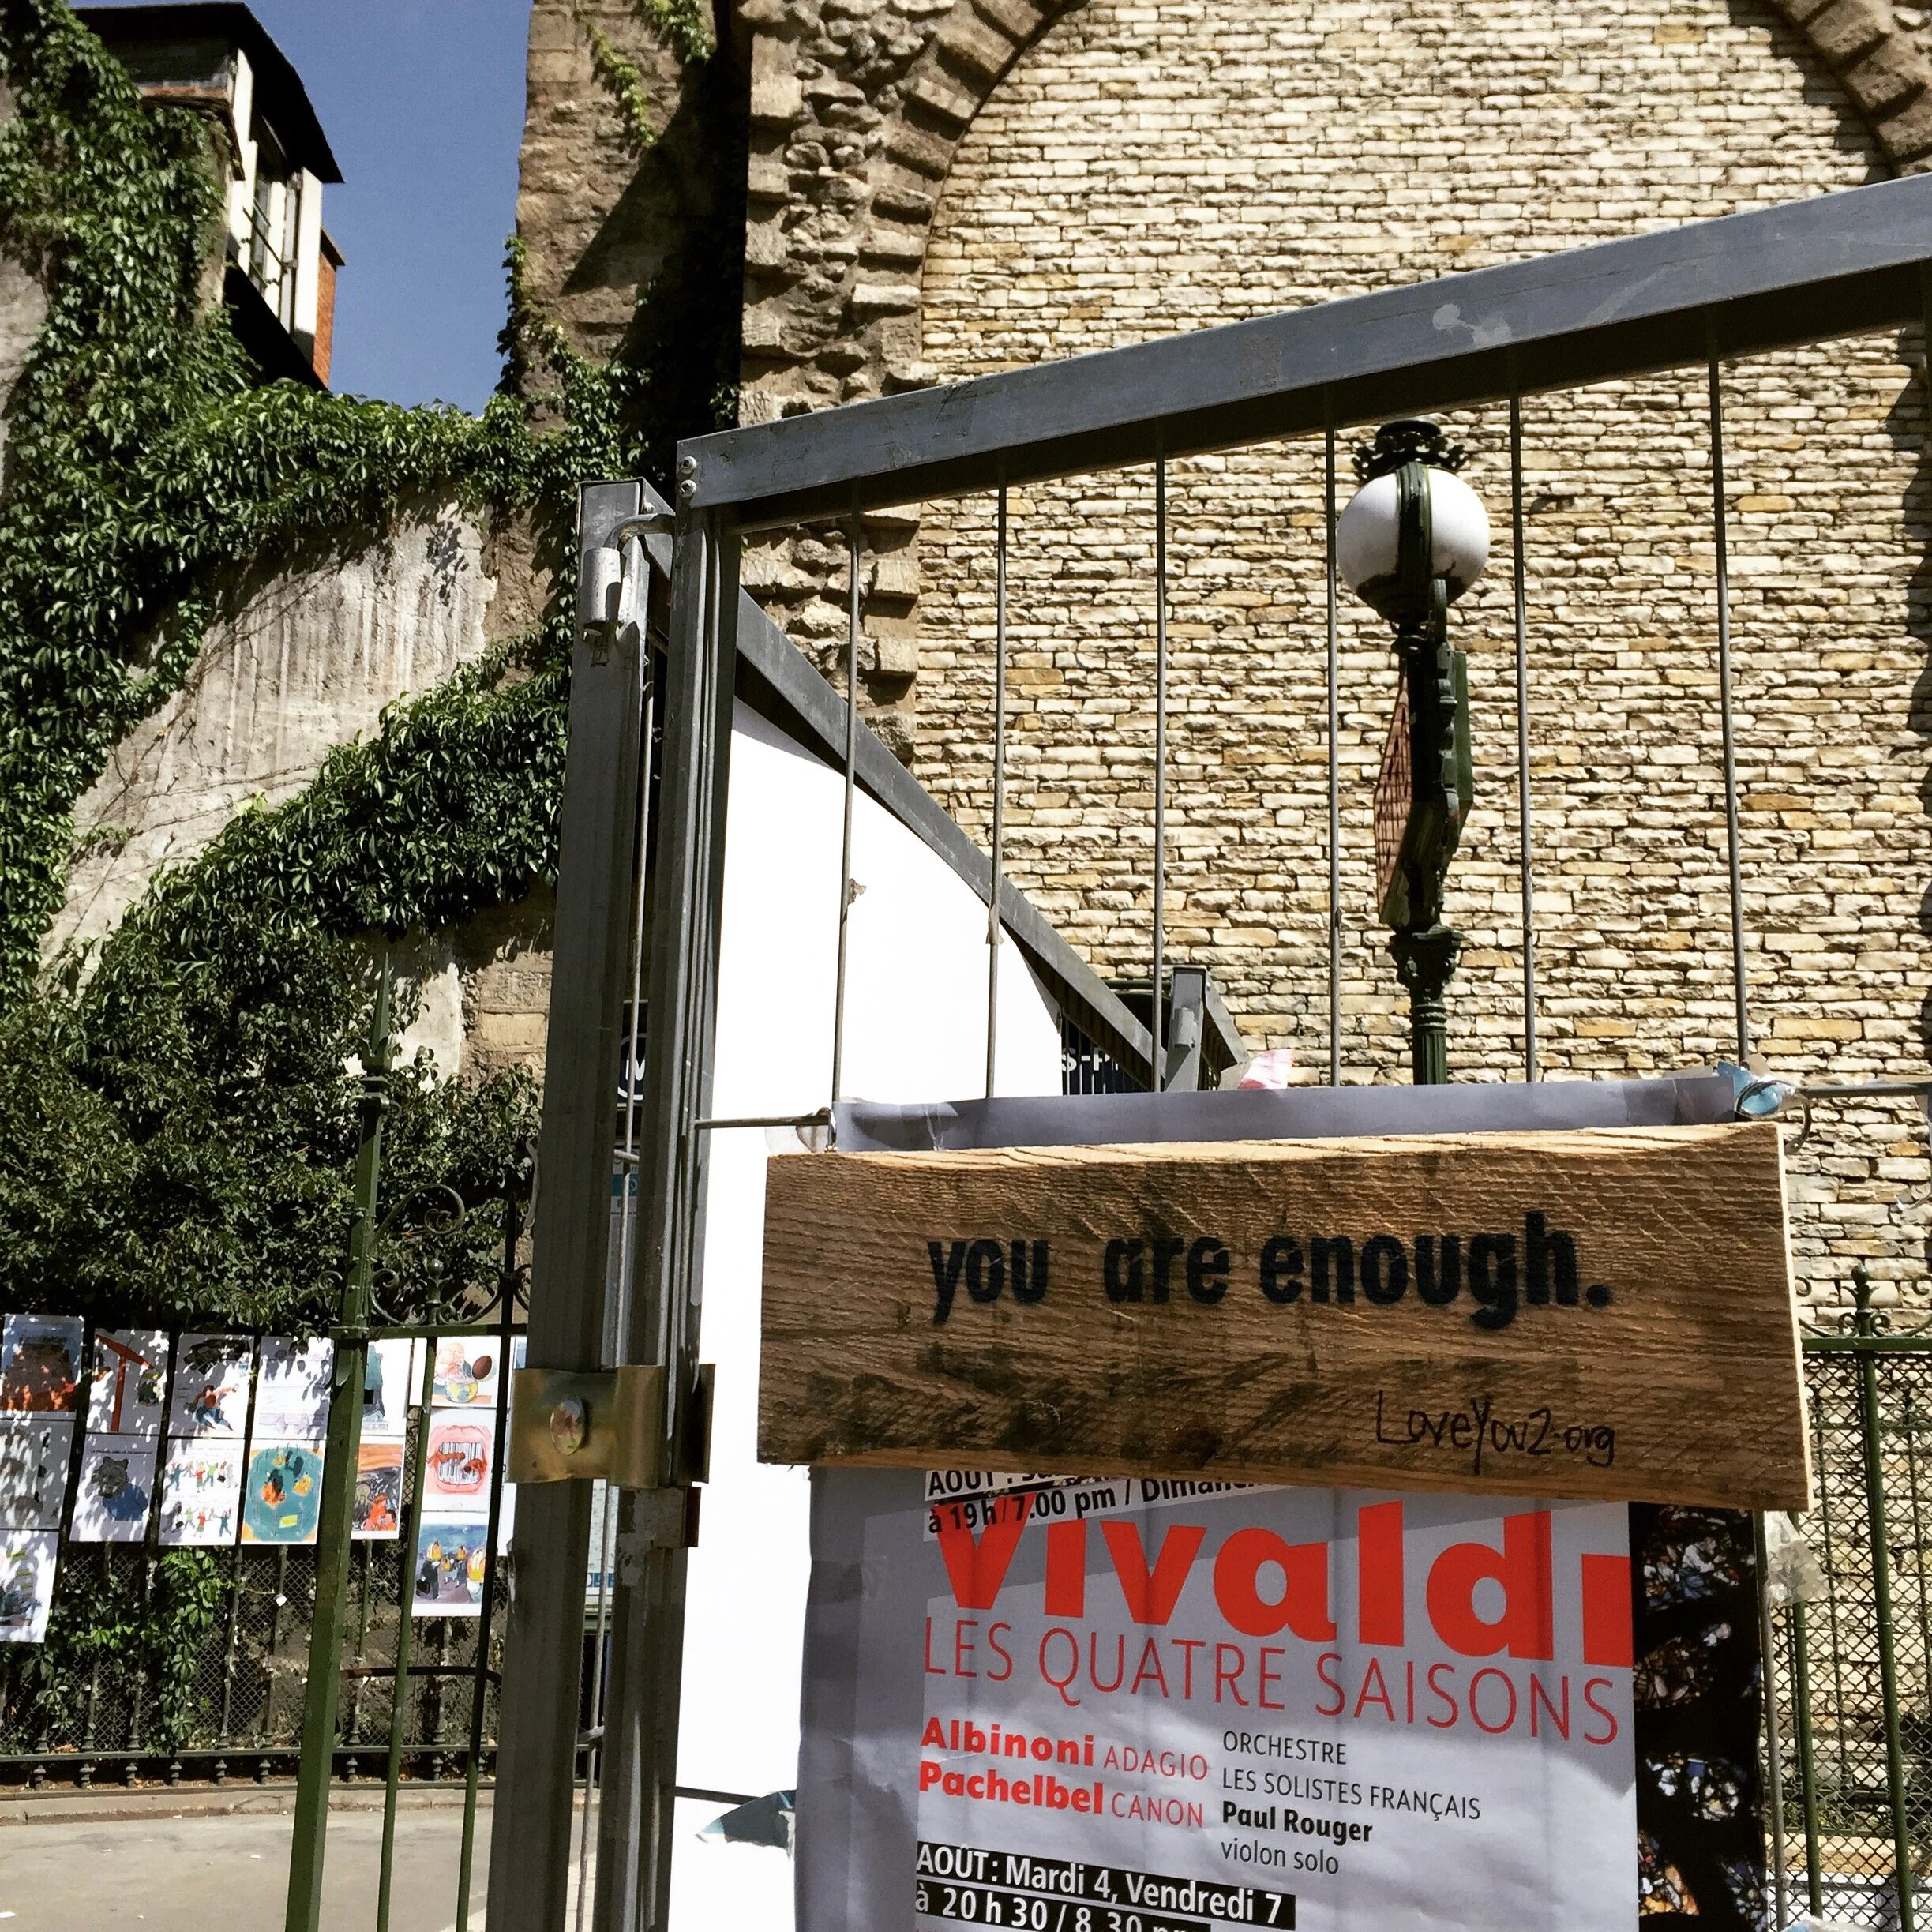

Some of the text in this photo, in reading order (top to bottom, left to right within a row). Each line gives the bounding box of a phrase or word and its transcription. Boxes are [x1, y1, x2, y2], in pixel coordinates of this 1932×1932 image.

[927, 1210, 1612, 1330] you are enough.
[928, 1508, 943, 1533] à
[1074, 1487, 1116, 1519] pm
[925, 1616, 1619, 1746] LES QUATRE SAISONS
[921, 1716, 1209, 1780] Albinoni ADAGIO
[1222, 1730, 1347, 1765] ORCHESTRE
[919, 1761, 1203, 1828] Pachelbel CANON
[1222, 1767, 1481, 1822] LES SOLISTES FRANÇAIS
[1222, 1800, 1373, 1846] Paul Rouger
[1221, 1837, 1339, 1875] violon solo
[915, 1888, 929, 1912] à
[942, 1887, 977, 1919] 20
[985, 1892, 1002, 1924] h
[1011, 1898, 1048, 1931] 30
[1006, 1855, 1085, 1895] Mardi
[1094, 1870, 1119, 1904] 4,
[1125, 1873, 1254, 1922] Vendredi
[1265, 1893, 1283, 1924] 7
